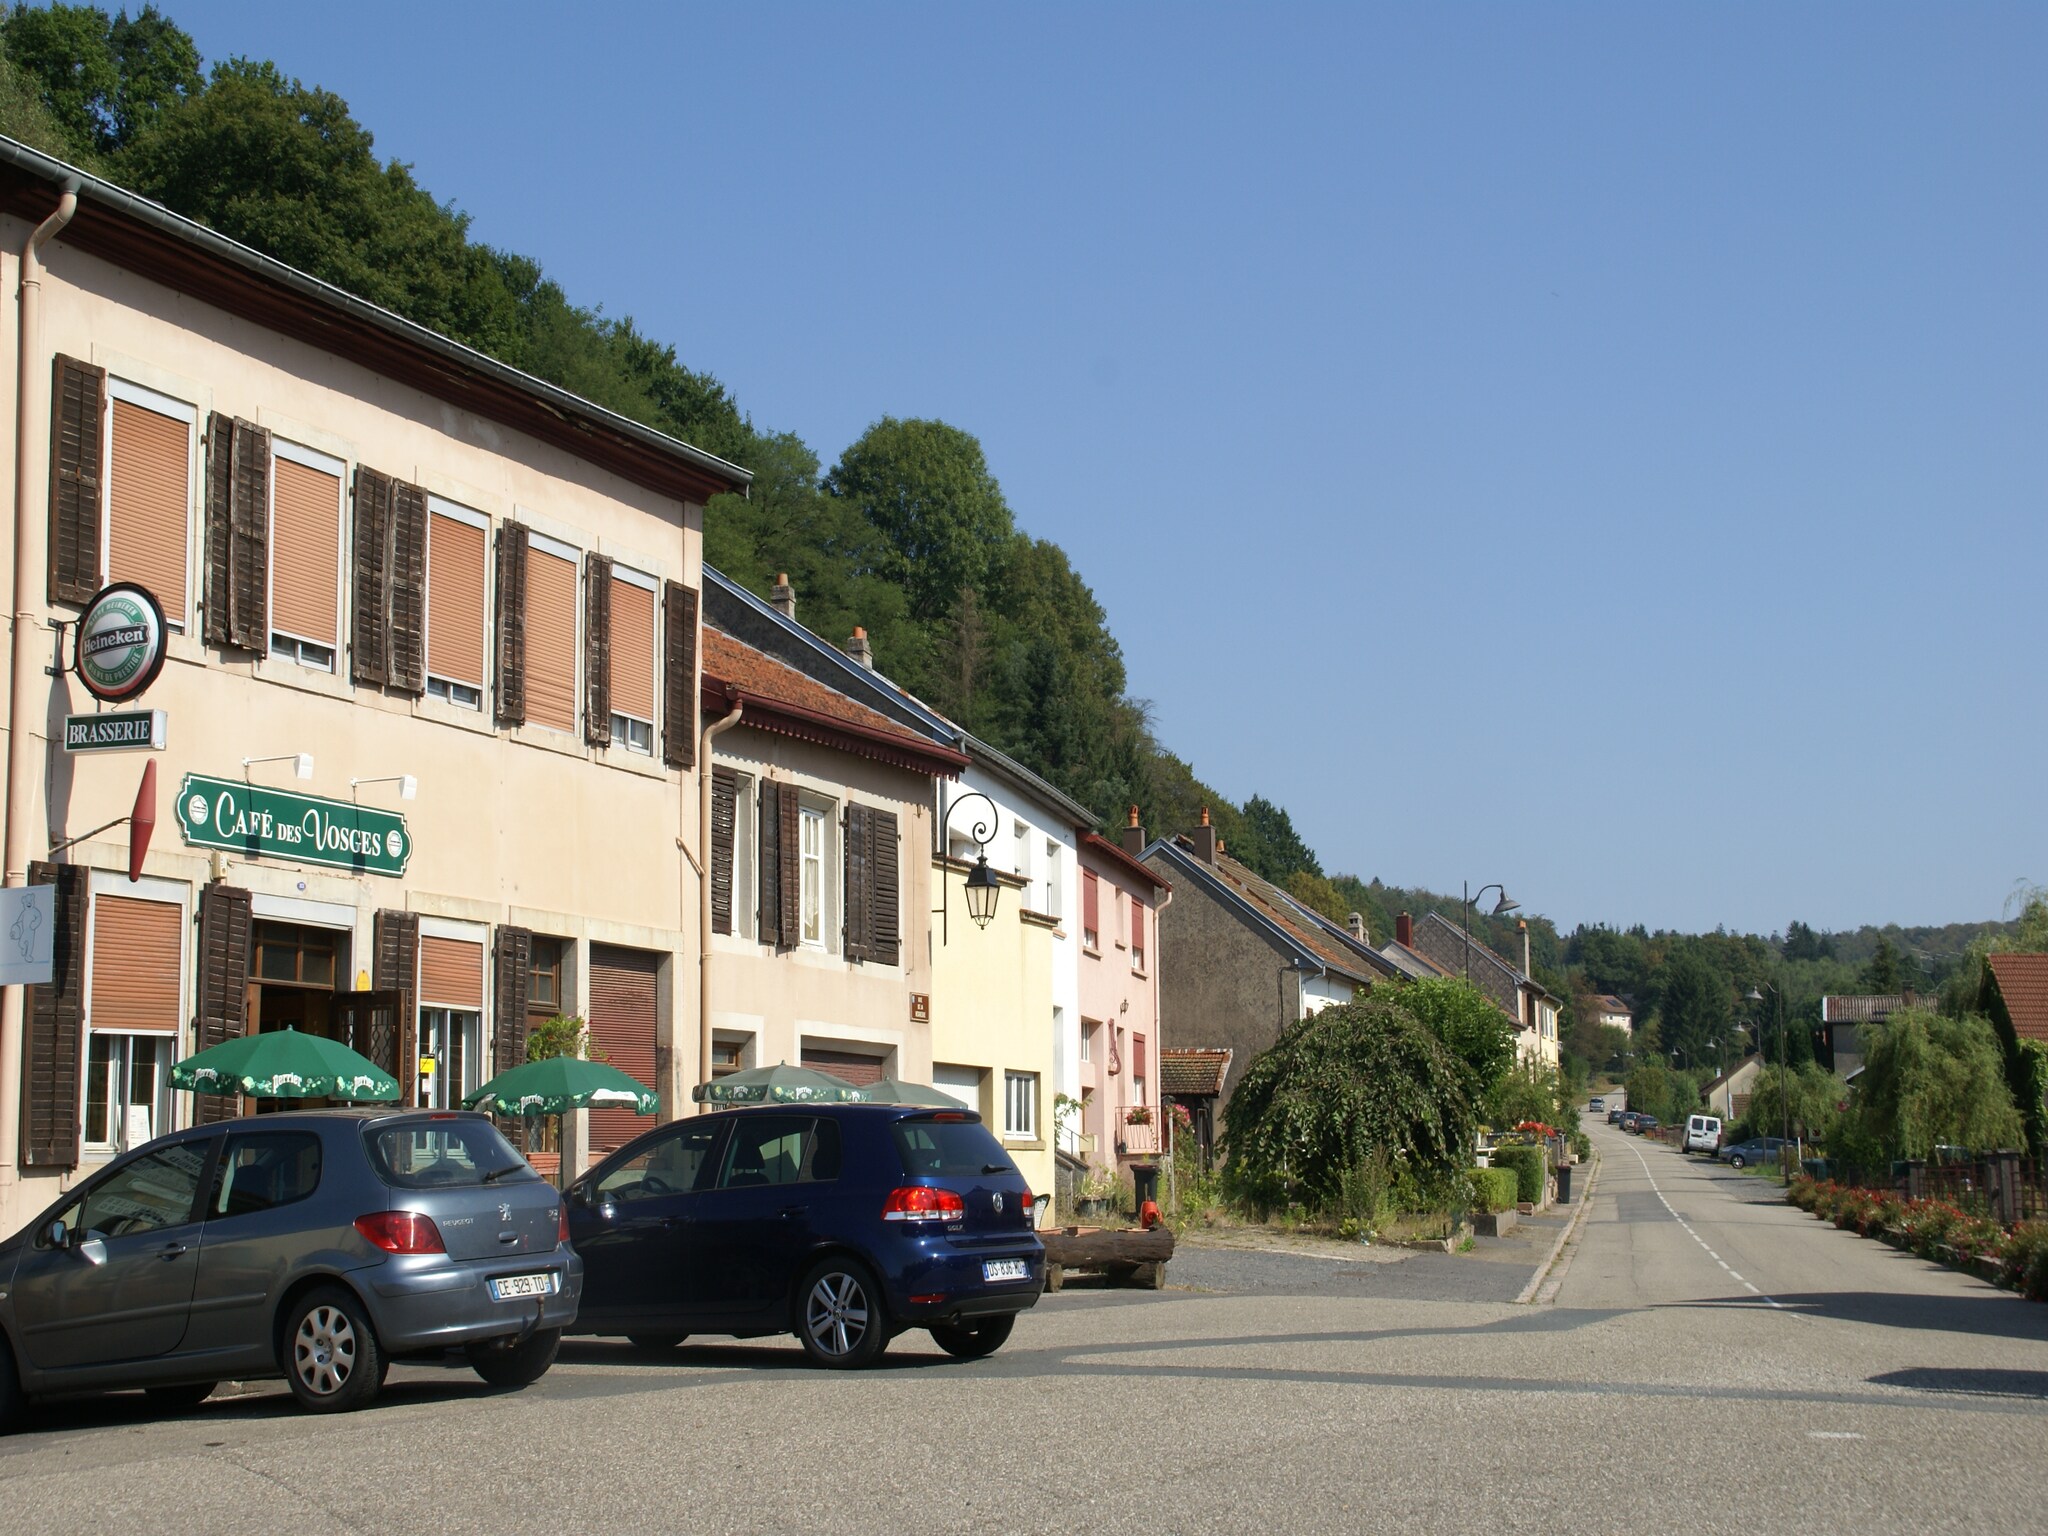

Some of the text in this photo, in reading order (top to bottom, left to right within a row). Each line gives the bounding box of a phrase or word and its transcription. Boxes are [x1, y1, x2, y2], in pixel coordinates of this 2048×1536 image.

[84, 630, 144, 654] Heineken
[114, 652, 141, 680] PRESTIGE
[68, 720, 150, 744] BRASSERIE
[277, 822, 302, 844] DES
[302, 808, 381, 857] VOSGES
[442, 1217, 474, 1227] PEUGEOT
